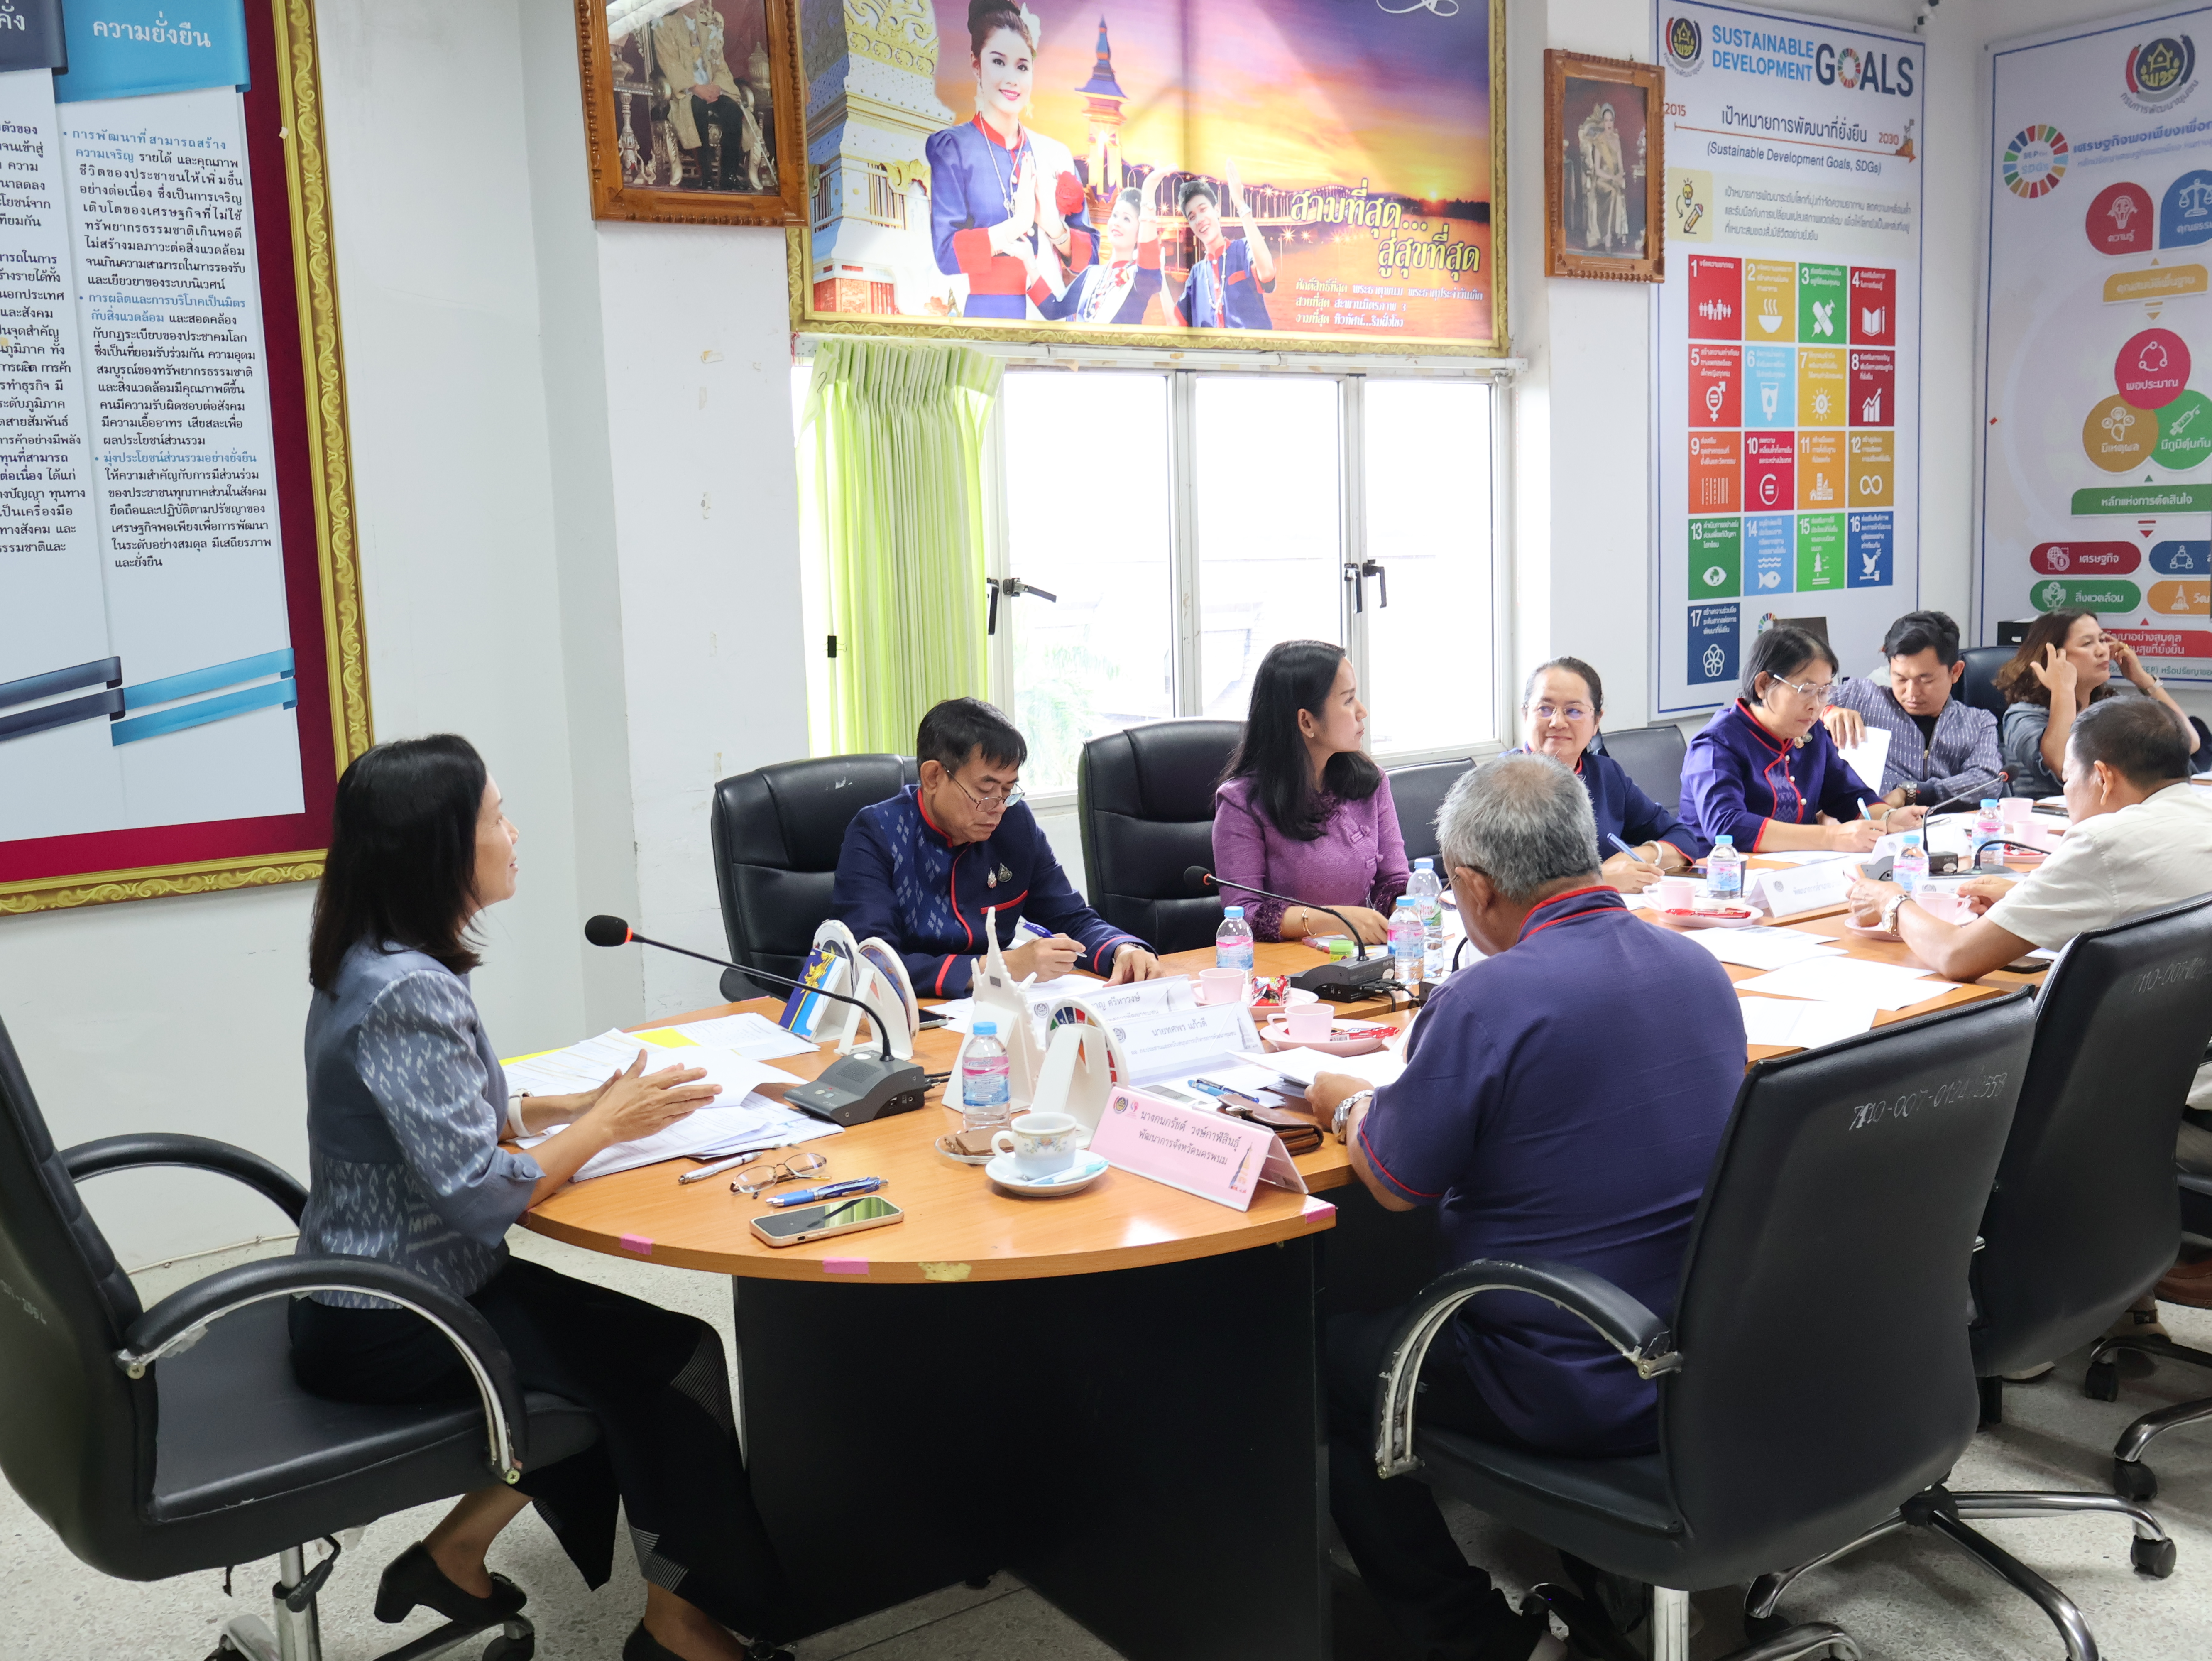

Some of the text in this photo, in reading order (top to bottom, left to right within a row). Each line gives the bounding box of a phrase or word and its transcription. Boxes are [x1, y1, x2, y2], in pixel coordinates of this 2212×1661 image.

[93, 11, 211, 47] ความยั่งยืน
[1712, 24, 1814, 59] SUSTAINABLE
[1712, 49, 1813, 82] DEVELOPMENT
[1816, 43, 1914, 97] GOALS
[1664, 102, 1686, 117] 2015
[0, 120, 38, 135] ตัวของ
[1721, 105, 1867, 143] เป้าหมายการพัฒนาที่ยั่งยืน
[1879, 132, 1899, 146] 2030
[0, 140, 44, 158] จนเข้าสู่
[1707, 140, 1765, 160] (Sustainable
[1767, 149, 1824, 167] Development
[1827, 156, 1853, 172] Goals,
[8, 161, 38, 171] ความ
[76, 148, 238, 170] ความเจริญ รายได้ และคุณภาพ
[80, 181, 242, 206] อย่างต่อเนื่อง ซึ่งเป็นการเจริญ
[84, 218, 242, 239] ทรัพยากรธรรมชาติเกินพอดี
[84, 234, 245, 257] ไม่สร้างมลภาวะต่อสิ่งแวดล้อม
[1378, 223, 1481, 283] สู่สุขที่สุด
[86, 255, 246, 274] จนเกินความสามารถในการรองรับ
[1691, 259, 1698, 277] 1
[1747, 262, 1756, 281] 2
[88, 273, 226, 290] และเยียวยาของระบบนิเวศน์
[1801, 267, 1810, 285] 3
[1852, 271, 1860, 288] 4
[88, 292, 246, 309] การผลิตและการบริโภคเป็นมิตร
[1295, 292, 1330, 310] สวยที่สุด
[1334, 298, 1397, 311] สะพานมิตรภาพ
[0, 306, 53, 318] และสังคม
[91, 305, 237, 326] กับสิ่งแวดล้อม และสอดคล้อง
[1295, 309, 1330, 327] งามที่สุด
[0, 324, 59, 340] นจุดสำคัญ
[94, 341, 256, 364] ซึ่งเป็นที่ยอมรับร่วมกัน ความอุดม
[1691, 348, 1700, 366] 5
[1747, 350, 1756, 368] 6
[1800, 352, 1808, 368] 7
[41, 360, 71, 373] การค้า
[1851, 353, 1860, 370] 8
[96, 363, 253, 379] สมบูรณ์ของทรัพยากรธรรมชาติ
[55, 378, 63, 390] มี
[98, 377, 245, 397] และสิ่งแวดล้อมมีคุณภาพดีขึ้น
[2126, 379, 2179, 391] พอประมาณ
[100, 398, 245, 412] คนมีความรับผิดชอบต่อสังคม
[101, 412, 243, 429] มีความเอื้ออาทร เสียสละเพื่อ
[103, 432, 206, 446] ผลประโยชน์ส่วนรวม
[1691, 437, 1700, 456] 9
[1747, 437, 1759, 455] 10
[1800, 437, 1810, 453] 11
[1850, 436, 1862, 453] 12
[104, 447, 257, 466] มุ่งประโยชน์ส่วนรวมอย่างยั่งยืน
[0, 465, 76, 480] ต่อเนื่อง ได้แก่
[105, 468, 259, 482] ให้ความสำคัญกับการมีส่วนร่วม
[49, 490, 86, 502] ทุนทาง
[108, 484, 267, 501] ของประชาชนทุกภาคส่วนในสังคม
[110, 502, 266, 517] ยึดถือและปฏิบัติตามปรัชญาของ
[56, 525, 76, 534] และ
[111, 516, 269, 535] เศรษฐกิจพอเพียงเพื่อการพัฒนา
[1691, 522, 1703, 540] 13
[1747, 520, 1758, 537] 14
[1799, 518, 1810, 535] 15
[1850, 516, 1861, 533] 16
[0, 540, 66, 553] รรมชาติและ
[112, 537, 272, 552] ในระดับอย่างสมดุล มีเสถียรภาพ
[115, 552, 163, 568] และยั่งยืน
[2079, 553, 2120, 566] เศรษฐกิจ
[2075, 590, 2124, 603] สิ่งแวดล้อม
[1690, 609, 1702, 627] 17
[1138, 1128, 1228, 1166] พัฒนาการจังหวัดนครพนม
